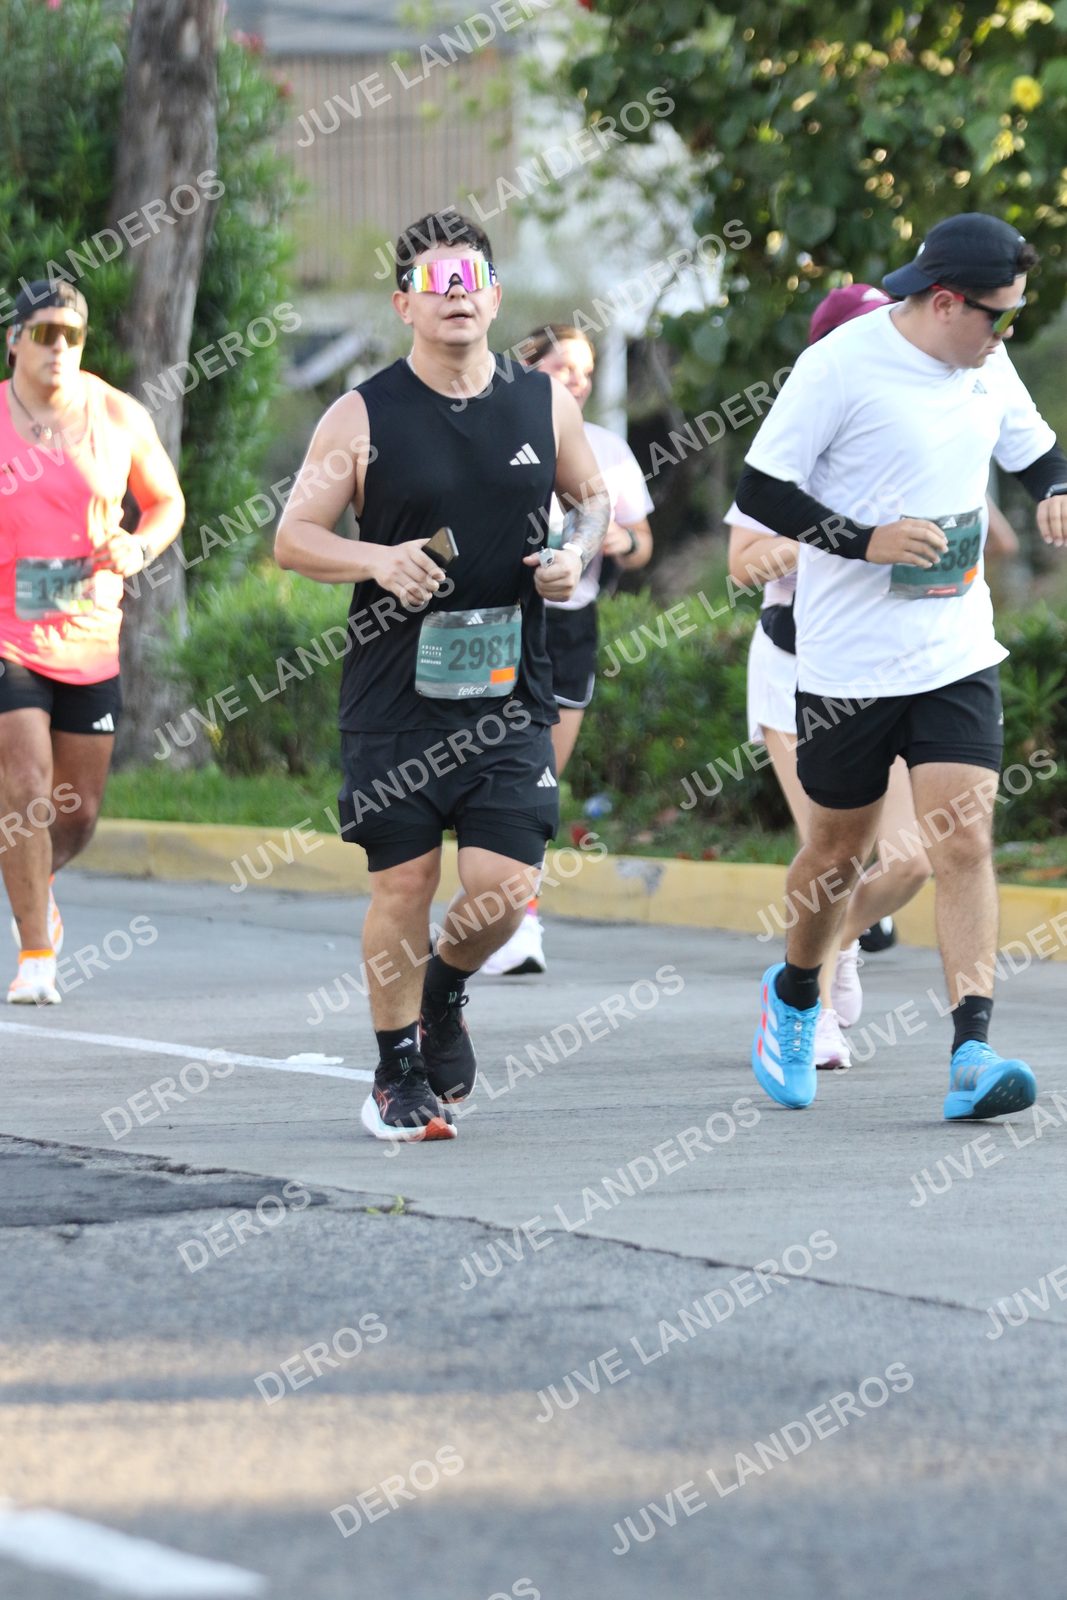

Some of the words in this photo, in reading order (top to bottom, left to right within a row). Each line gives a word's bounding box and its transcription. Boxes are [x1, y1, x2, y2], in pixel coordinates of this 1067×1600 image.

[924, 535, 981, 572] 582
[448, 632, 518, 671] 2981
[457, 685, 488, 696] telcel
